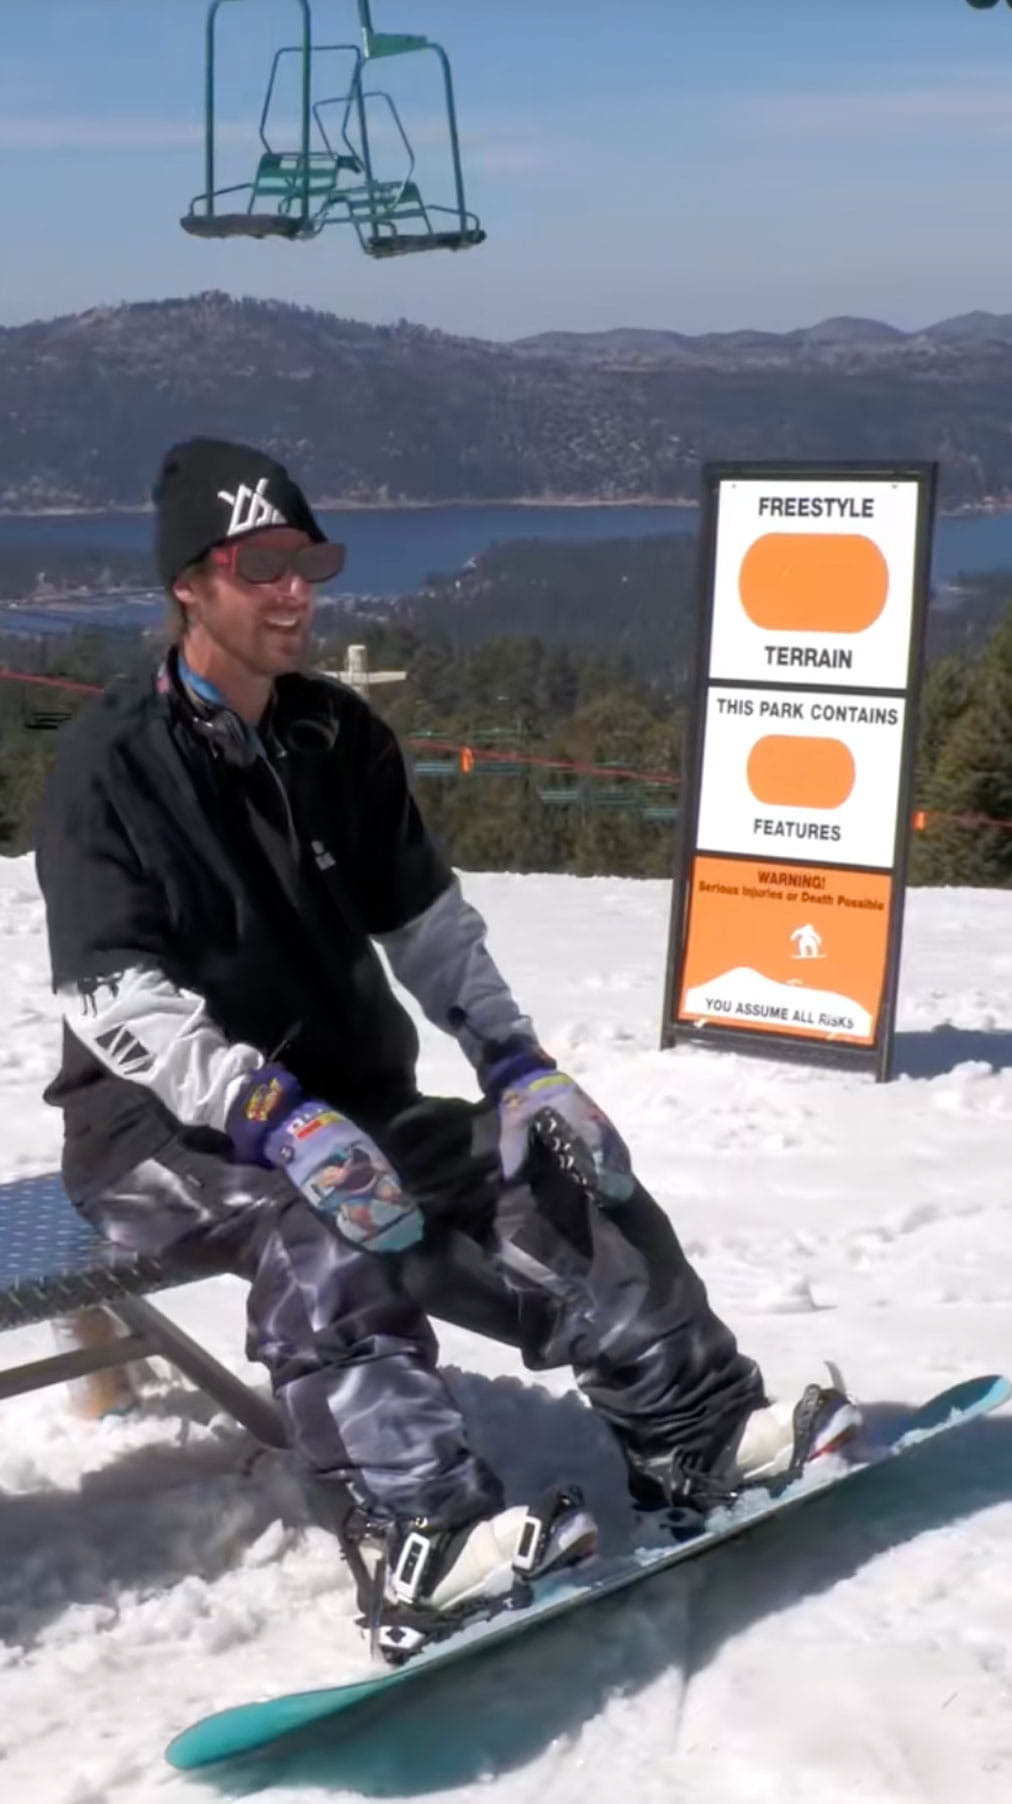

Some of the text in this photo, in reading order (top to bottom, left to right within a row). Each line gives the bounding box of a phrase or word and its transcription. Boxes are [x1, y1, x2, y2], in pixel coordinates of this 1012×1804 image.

[759, 497, 874, 517] FREESTYLE
[765, 646, 852, 668] TERRAIN
[718, 698, 898, 725] THIS PARK CONTAINS
[753, 818, 841, 841] FEATURES
[758, 870, 826, 889] WARNING!
[699, 881, 884, 910] Serious Injuries or Death Possible
[706, 998, 732, 1013] YOU
[735, 1003, 788, 1020] ASSUME
[793, 1010, 813, 1024] ALL
